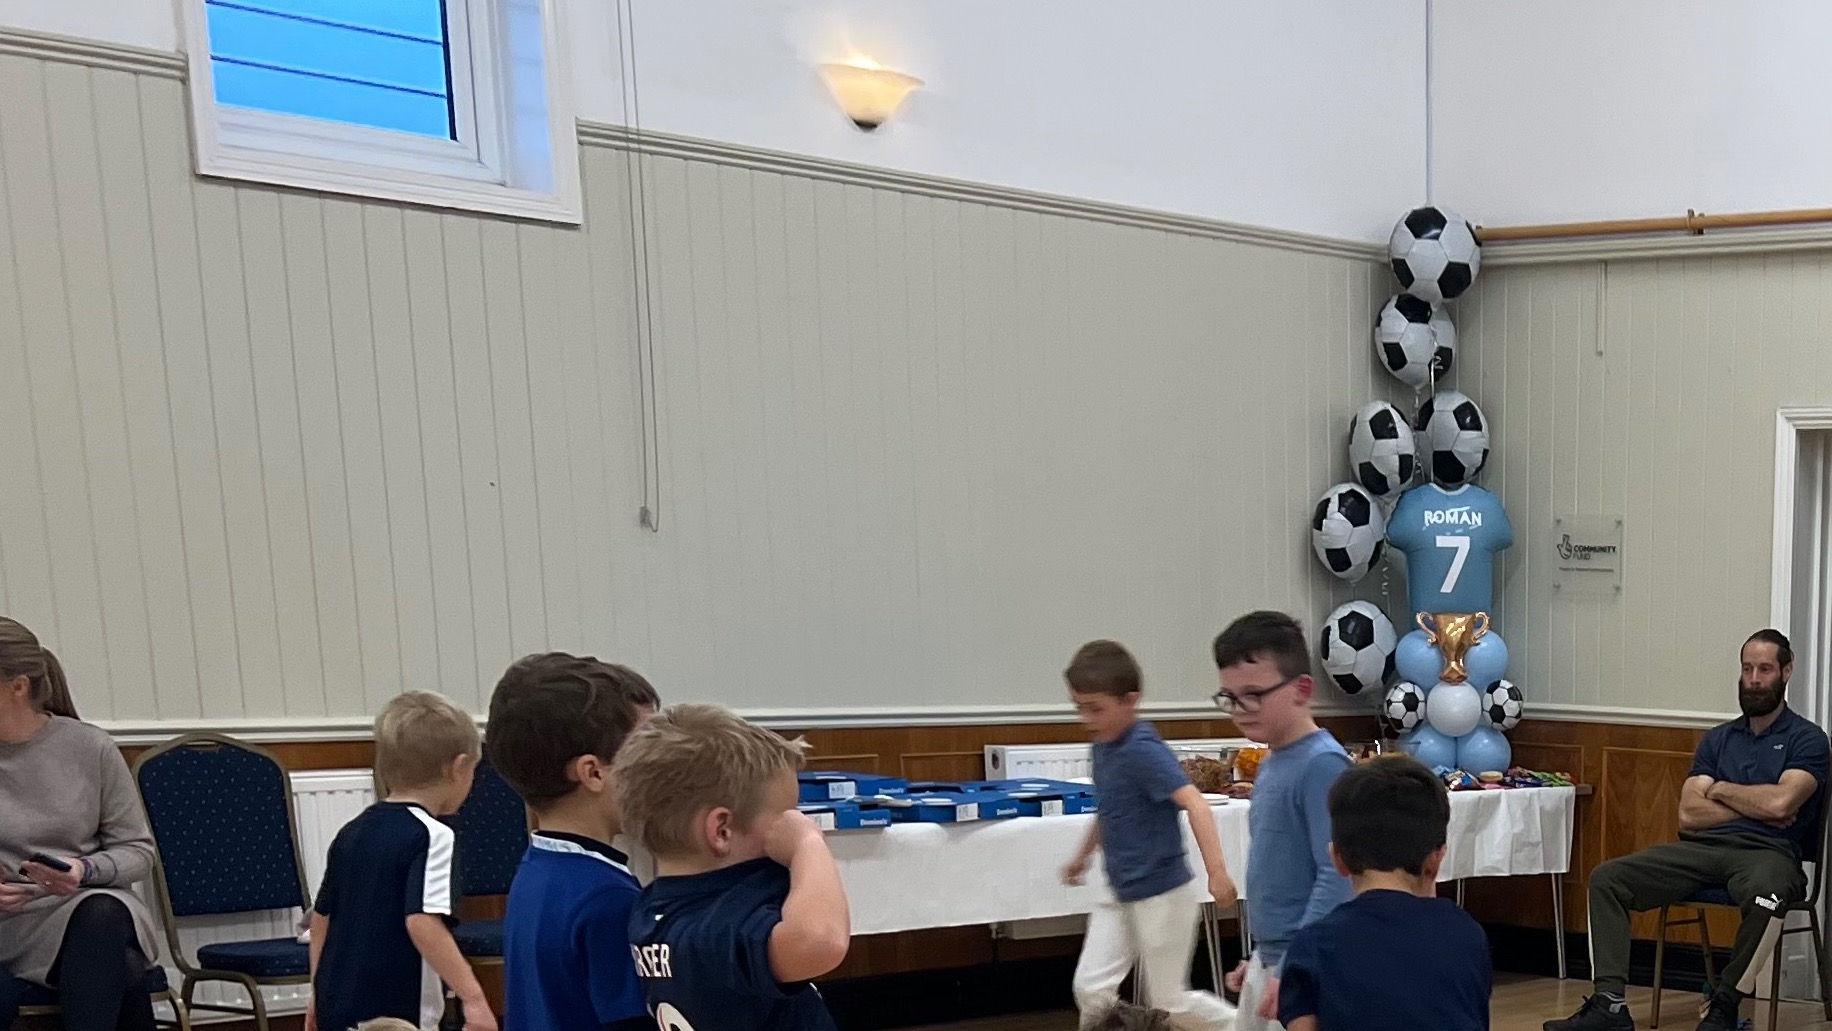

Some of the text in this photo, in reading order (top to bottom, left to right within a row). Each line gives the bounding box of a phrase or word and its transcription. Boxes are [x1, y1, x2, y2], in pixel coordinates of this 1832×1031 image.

[1424, 508, 1482, 526] ROMAN
[1574, 545, 1617, 553] COMMUNITY
[1435, 535, 1471, 594] 7
